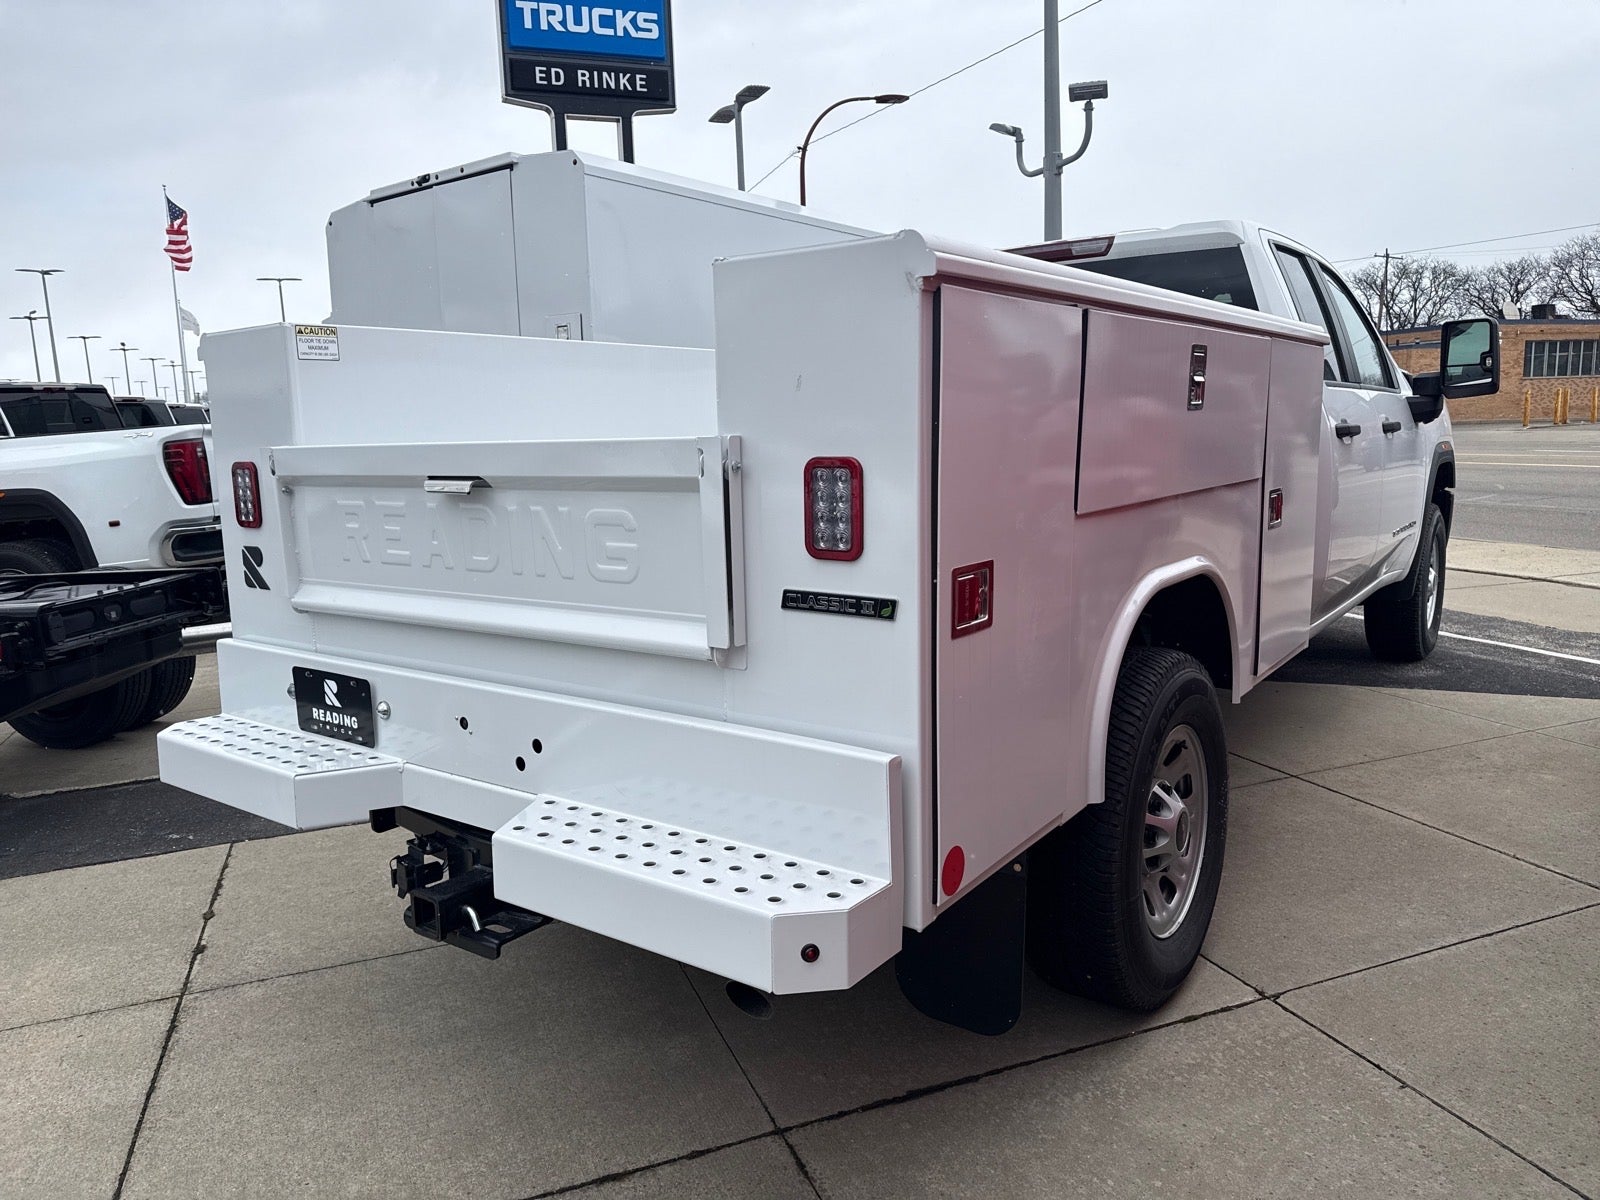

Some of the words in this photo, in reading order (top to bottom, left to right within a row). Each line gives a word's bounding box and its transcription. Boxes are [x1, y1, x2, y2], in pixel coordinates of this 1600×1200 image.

[516, 1, 660, 40] TRUCKS
[535, 66, 565, 86] ED
[577, 69, 648, 92] RINKE
[303, 327, 336, 336] CAUTION
[336, 501, 640, 585] READING
[785, 593, 856, 612] CLASSIC
[860, 600, 875, 615] II
[311, 707, 359, 730] READING
[319, 723, 353, 736] TRUCK
